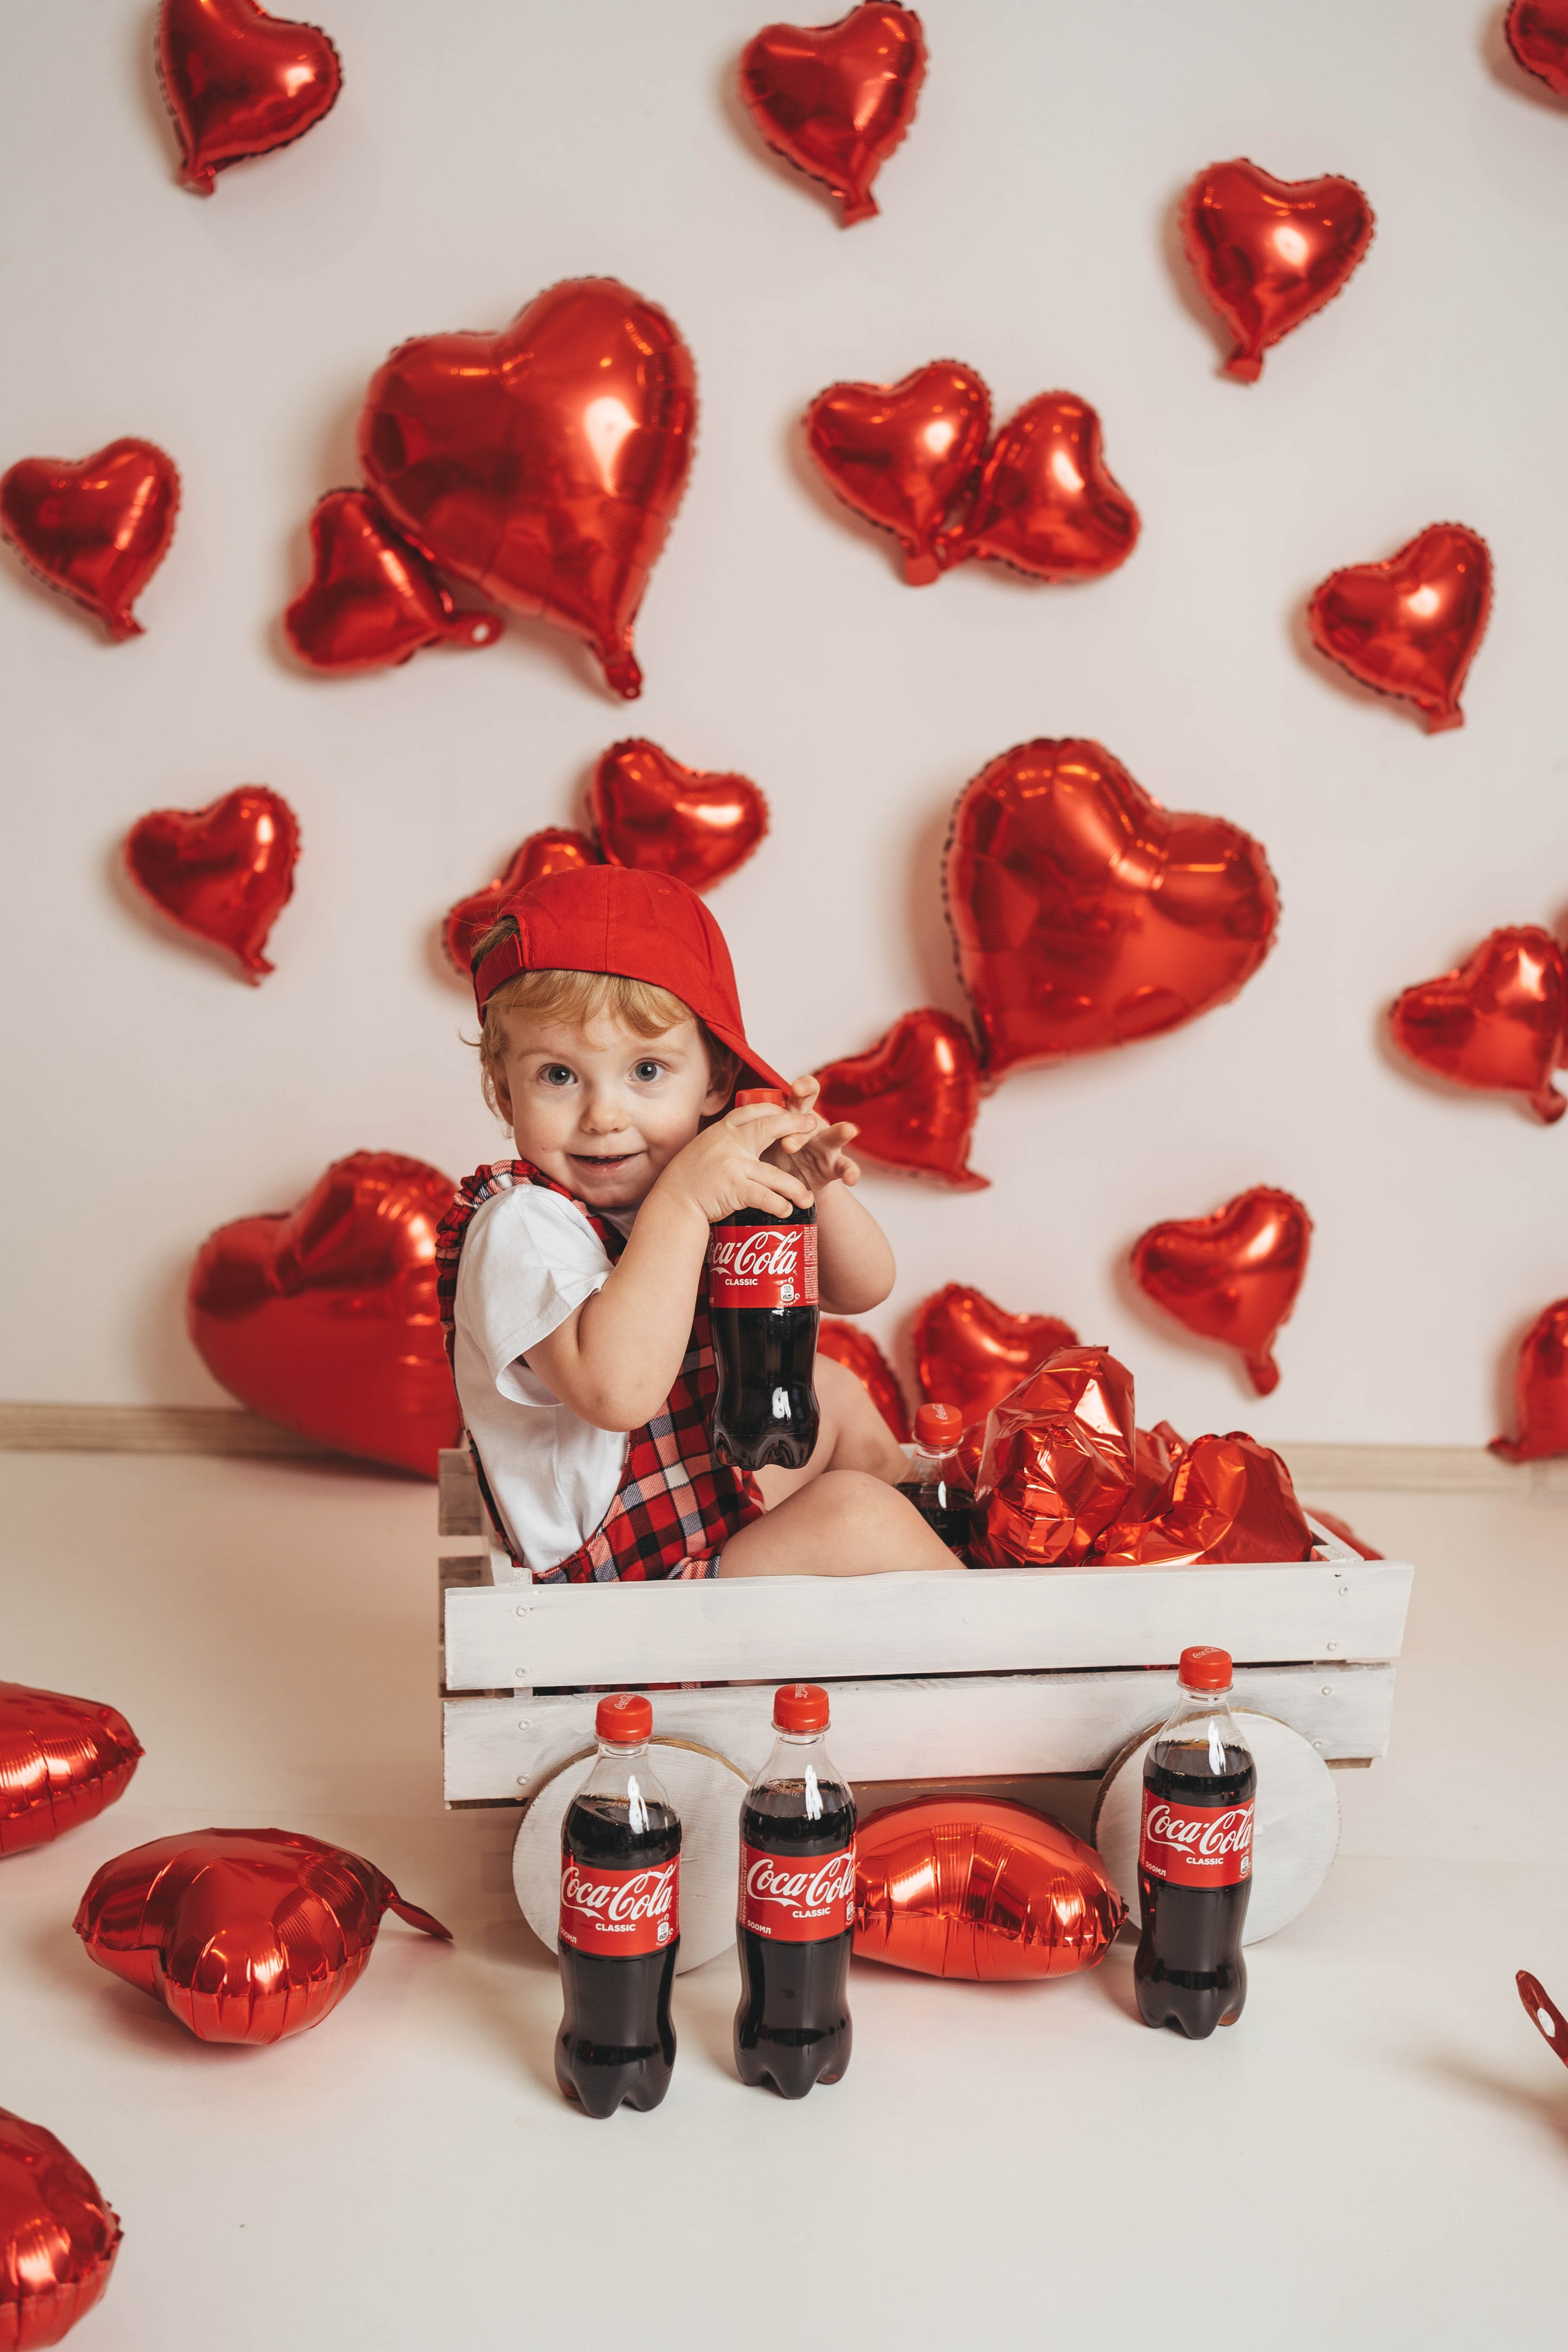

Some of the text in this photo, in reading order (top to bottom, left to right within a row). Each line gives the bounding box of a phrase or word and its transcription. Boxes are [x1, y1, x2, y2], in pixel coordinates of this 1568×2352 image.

[1147, 1803, 1254, 1855] Coca-Cola
[561, 1861, 677, 1921] Coca-Cola
[747, 1845, 856, 1907] Coca-Cola
[595, 1923, 636, 1932] CLASSIC
[747, 1920, 772, 1934] 500МЛ
[792, 1907, 831, 1918] CLASSIC
